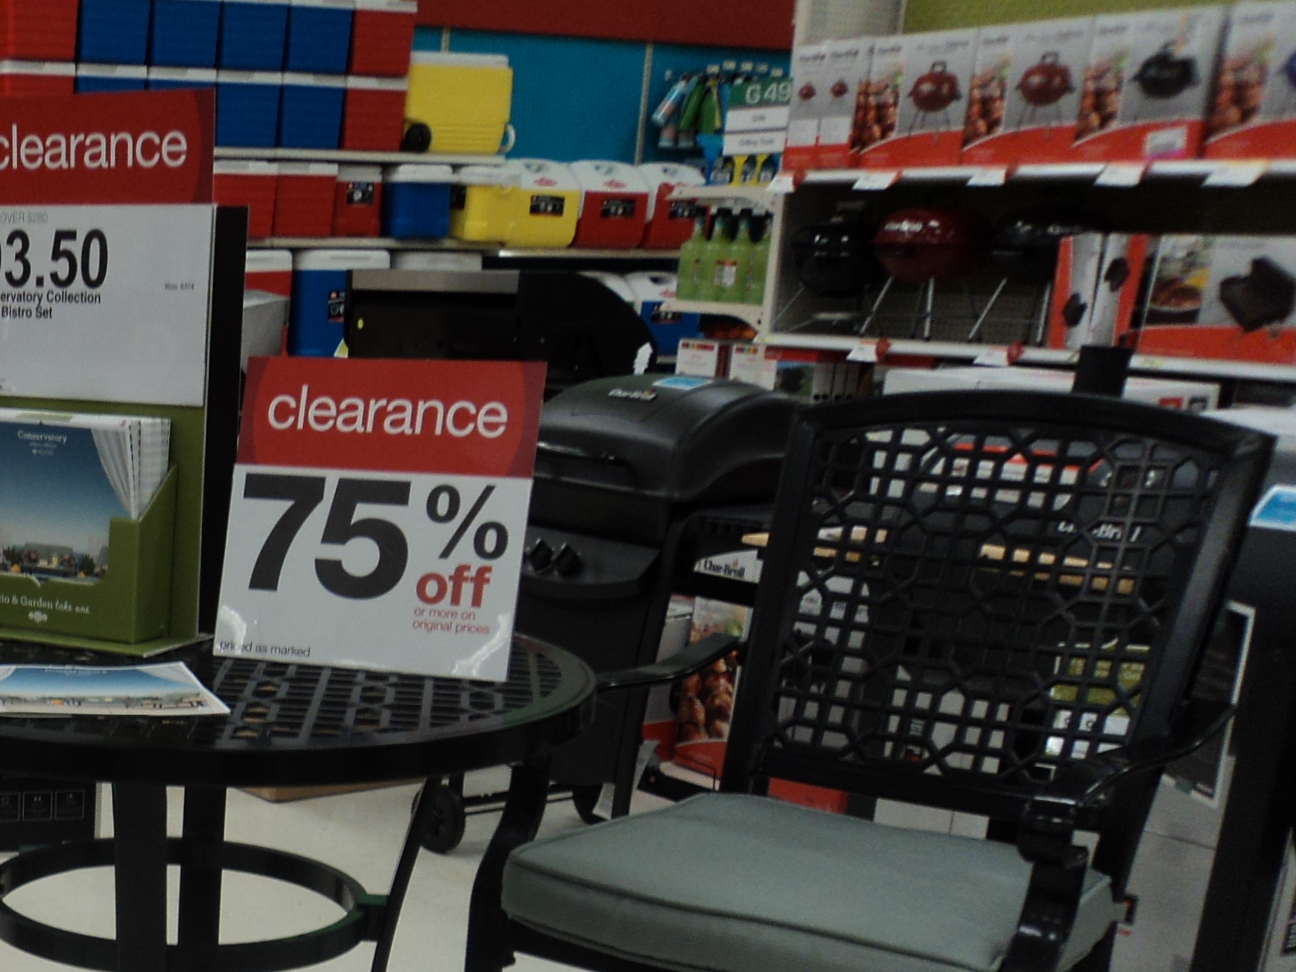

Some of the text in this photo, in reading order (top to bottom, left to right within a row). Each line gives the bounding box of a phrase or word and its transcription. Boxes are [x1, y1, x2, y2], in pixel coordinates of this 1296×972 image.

[0, 212, 25, 224] OVER
[46, 290, 101, 304] Collection
[1, 306, 33, 319] Bistro
[35, 306, 53, 319] Set
[267, 383, 508, 439] clearance
[243, 472, 509, 600] 75%
[415, 564, 493, 609] off
[11, 594, 19, 605] &
[20, 595, 54, 610] Garden
[55, 597, 73, 612] take
[414, 608, 476, 621] or more on
[412, 618, 490, 635] original prices
[255, 644, 268, 654] as
[270, 645, 311, 658] marked
